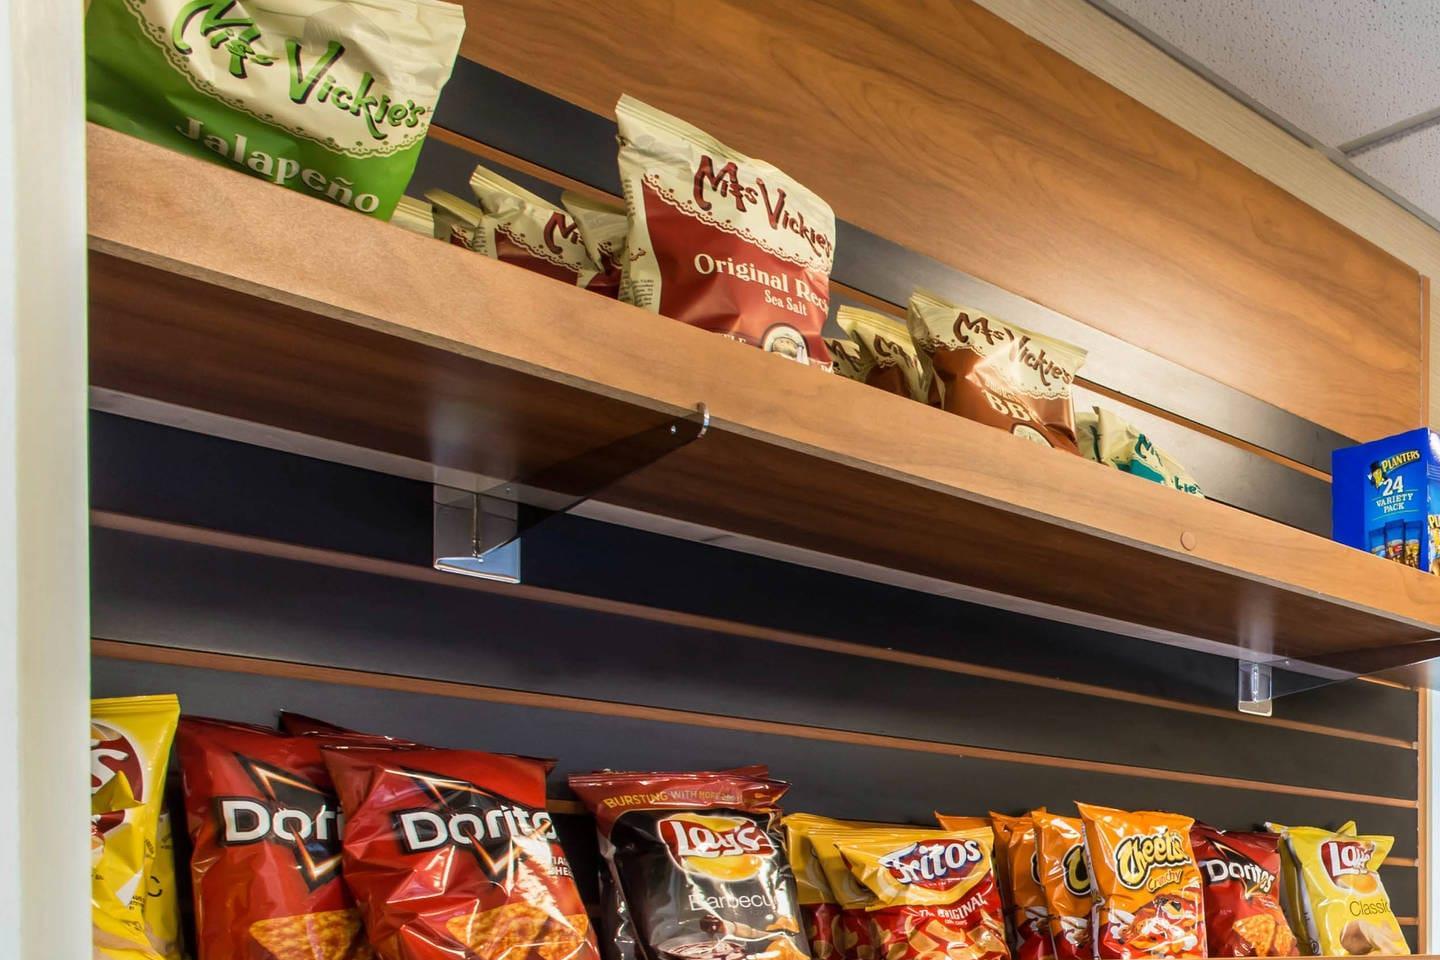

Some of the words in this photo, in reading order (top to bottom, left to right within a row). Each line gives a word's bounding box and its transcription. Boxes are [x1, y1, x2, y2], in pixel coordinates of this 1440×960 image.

[176, 117, 380, 214] Jalapeño
[694, 253, 789, 293] Original
[764, 289, 784, 308] Sea
[787, 296, 808, 316] Salt
[1381, 450, 1420, 472] PLANTERS
[1383, 476, 1403, 496] 24
[1376, 493, 1413, 507] VARIETY
[1383, 503, 1404, 513] PACK
[603, 791, 668, 808] BURSTING
[670, 790, 697, 799] WITH
[669, 820, 760, 859] Lay's
[878, 840, 981, 884] Fritos
[1207, 859, 1275, 893] Doritos
[688, 892, 773, 911] Barbecu
[1349, 899, 1390, 917] Classic
